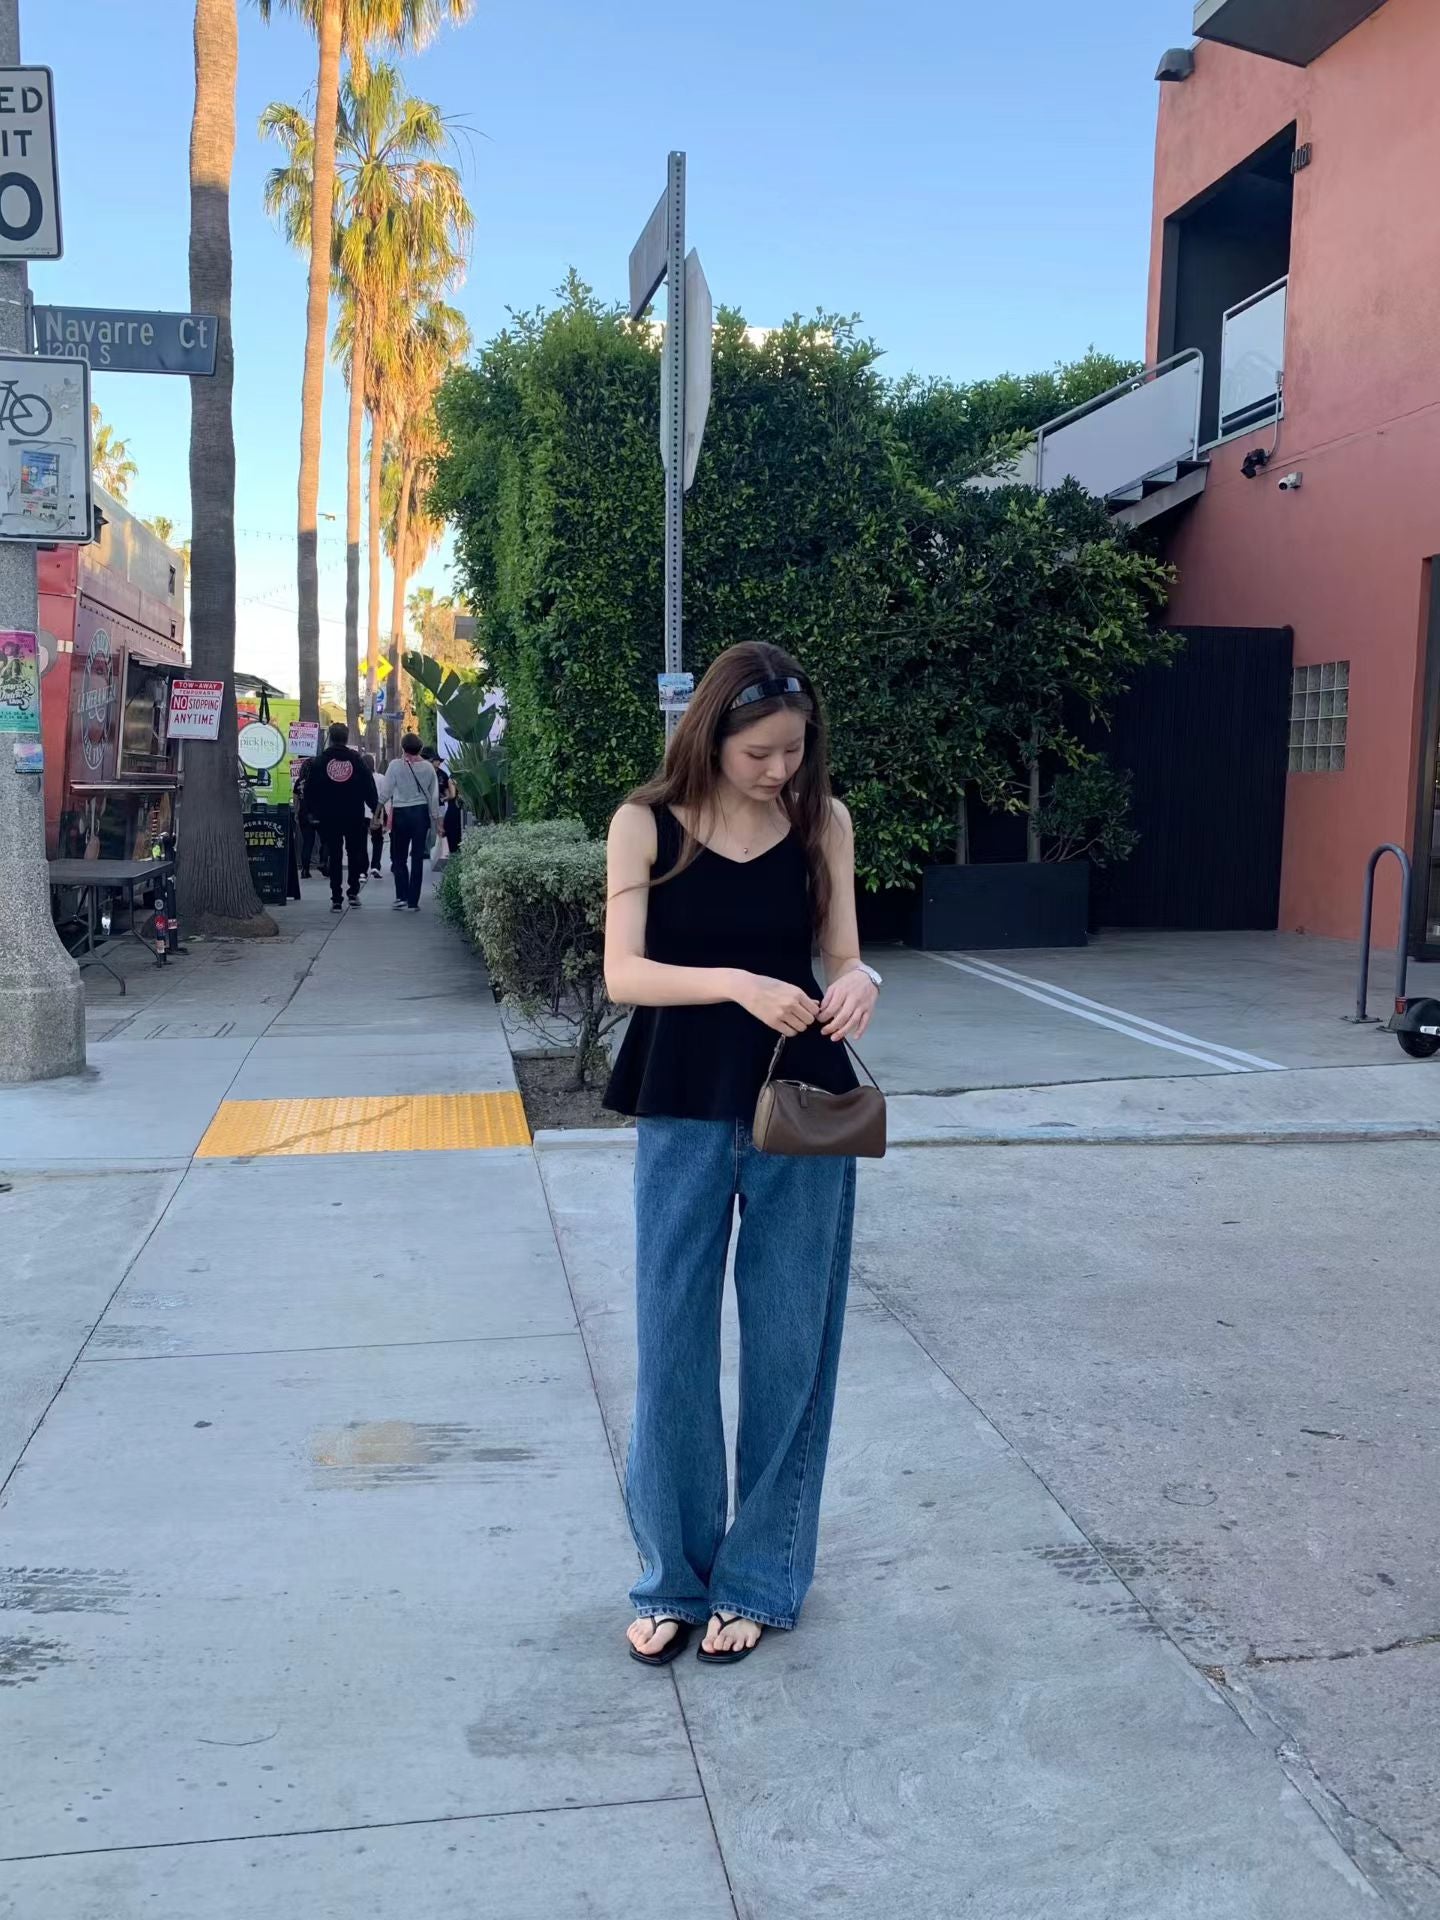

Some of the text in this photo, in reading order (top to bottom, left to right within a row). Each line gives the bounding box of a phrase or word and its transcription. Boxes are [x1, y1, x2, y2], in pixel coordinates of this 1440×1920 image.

[45, 312, 208, 349] Navarre Ct
[46, 342, 111, 365] 1200 S
[179, 682, 218, 690] TOW-AWAY
[173, 696, 219, 711] NO STOPPING
[173, 713, 215, 725] ANYTIME
